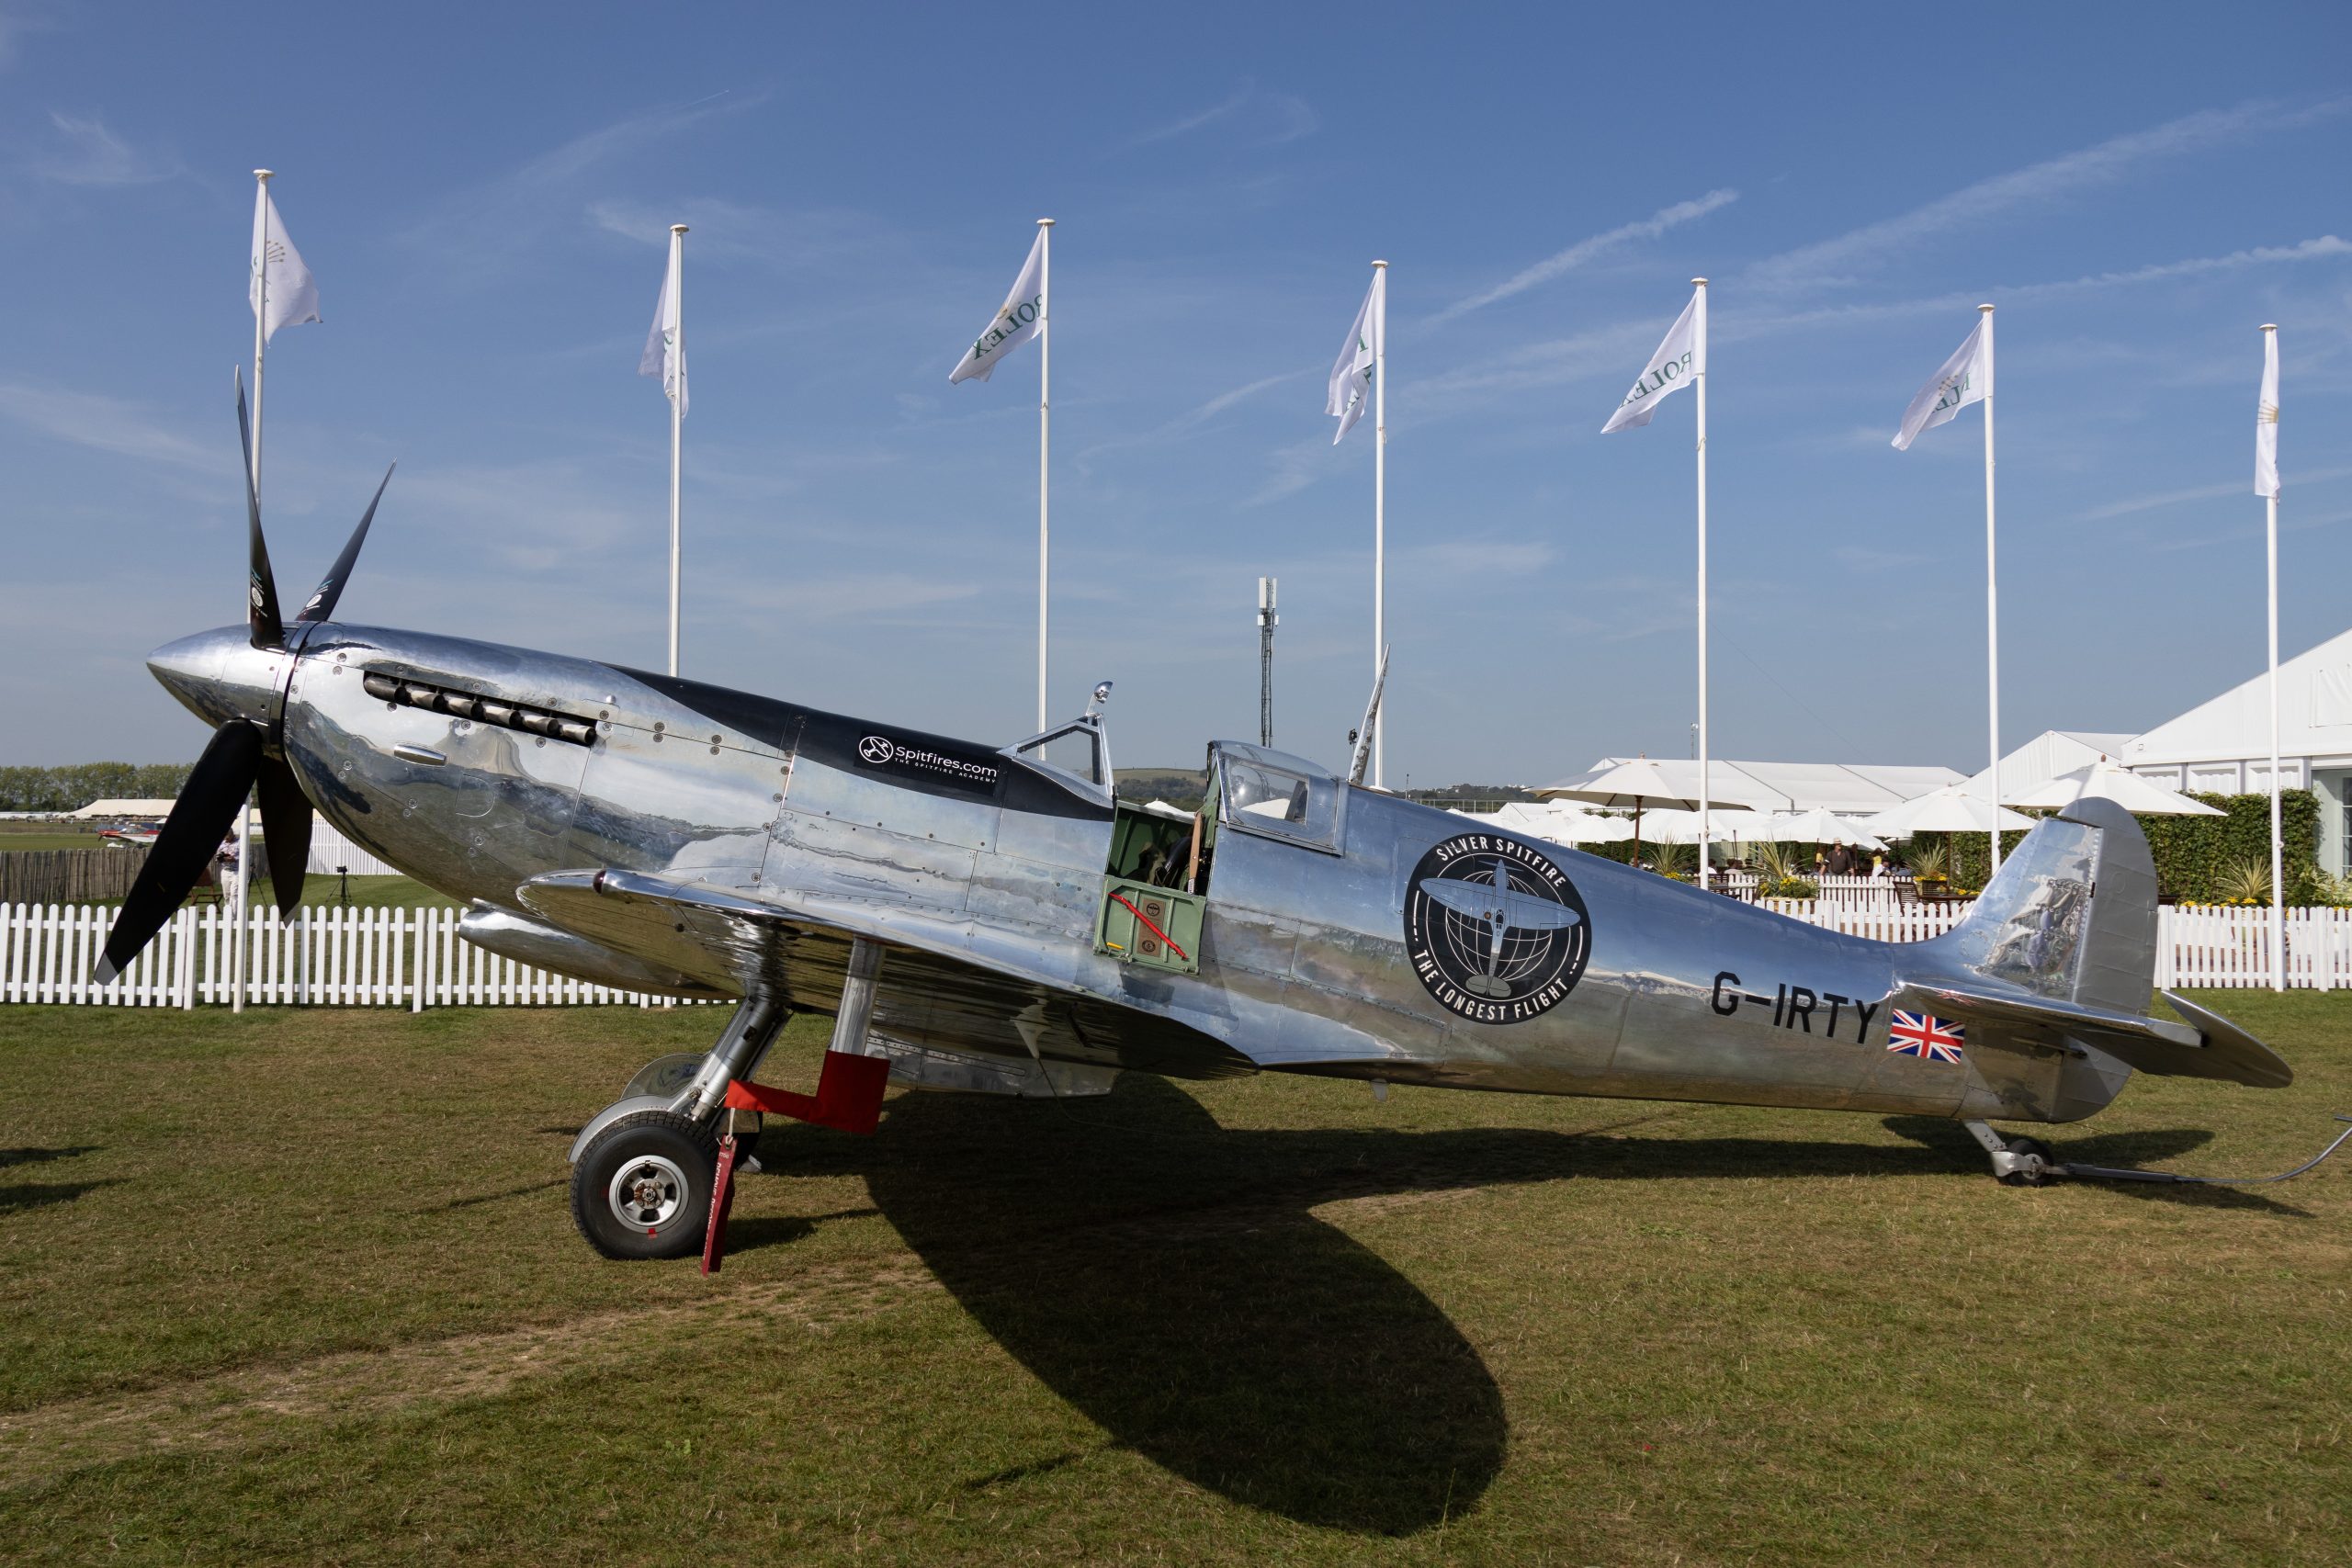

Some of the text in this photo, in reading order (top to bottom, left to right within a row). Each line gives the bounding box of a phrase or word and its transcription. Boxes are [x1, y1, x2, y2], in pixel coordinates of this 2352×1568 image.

[895, 746, 997, 777] Spitfires.com
[915, 762, 953, 774] SPITFIRE
[958, 772, 996, 784] ACADEMY
[1436, 836, 1566, 887] SILVER SPITFIRE
[1414, 949, 1568, 1021] THE LONGEST FLIGHT
[1711, 971, 1879, 1044] G-IRTY
